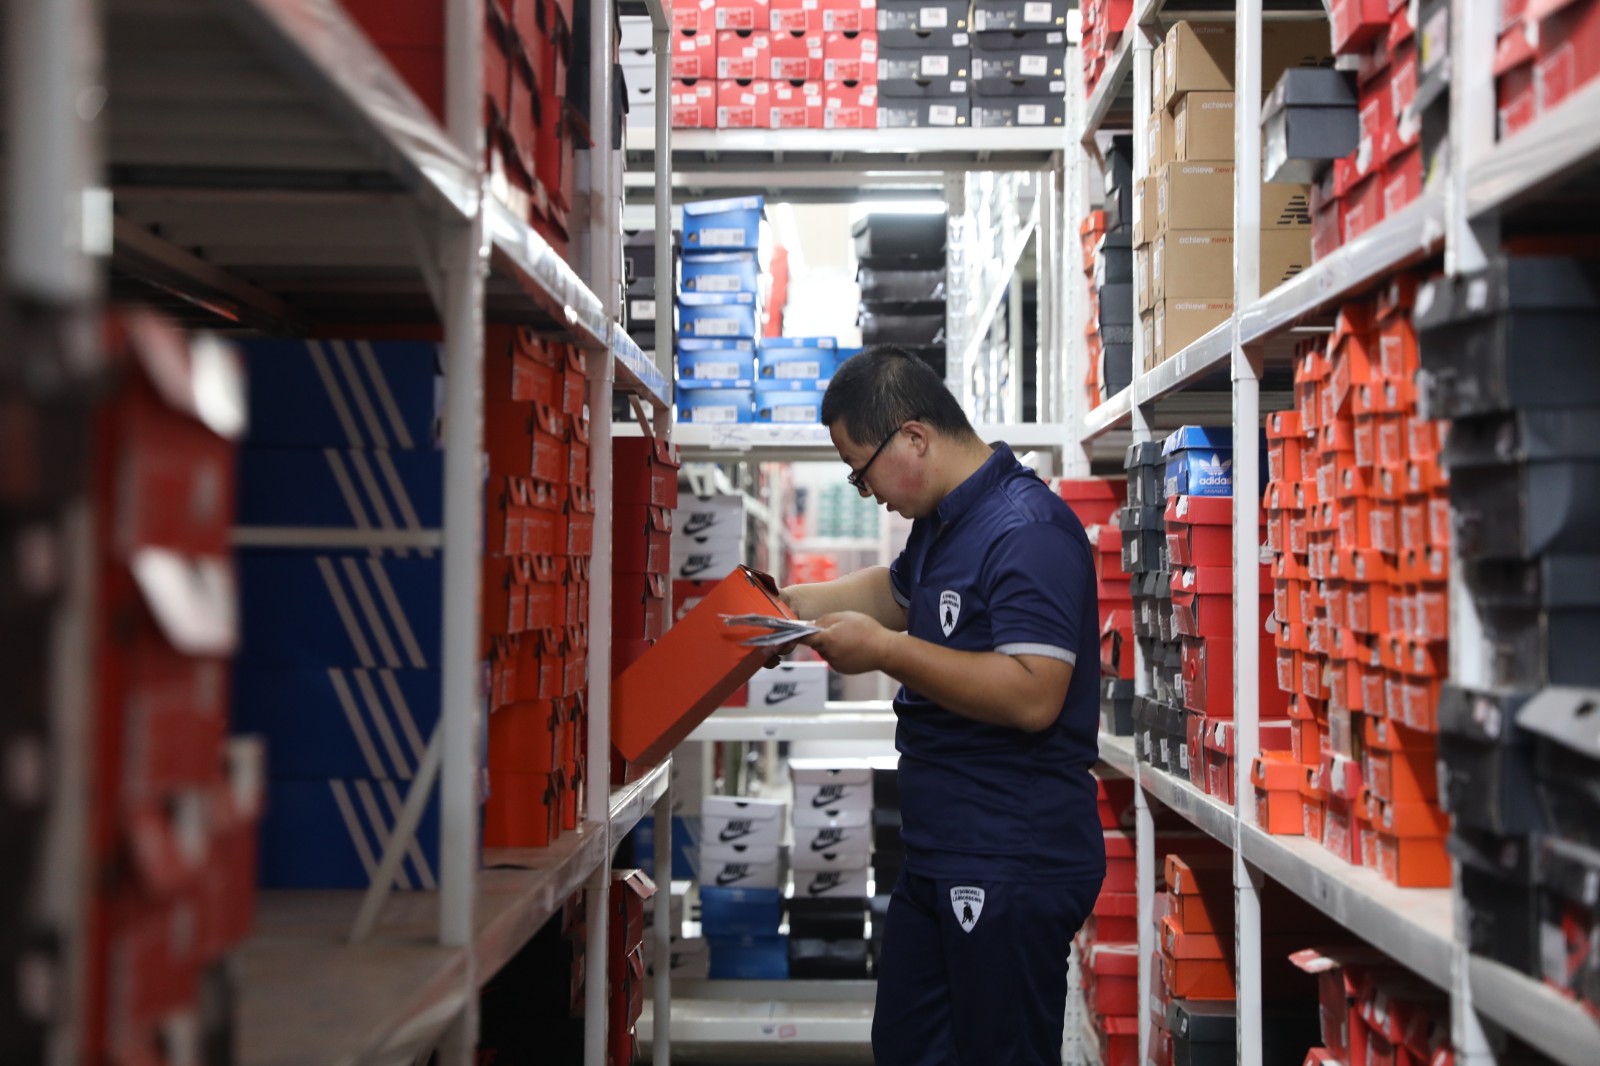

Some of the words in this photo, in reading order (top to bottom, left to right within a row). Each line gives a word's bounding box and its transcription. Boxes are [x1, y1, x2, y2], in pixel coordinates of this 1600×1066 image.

[1201, 100, 1233, 109] achieve
[1182, 166, 1214, 174] achieve
[1178, 236, 1210, 244] achieve
[1175, 302, 1207, 310] achieve
